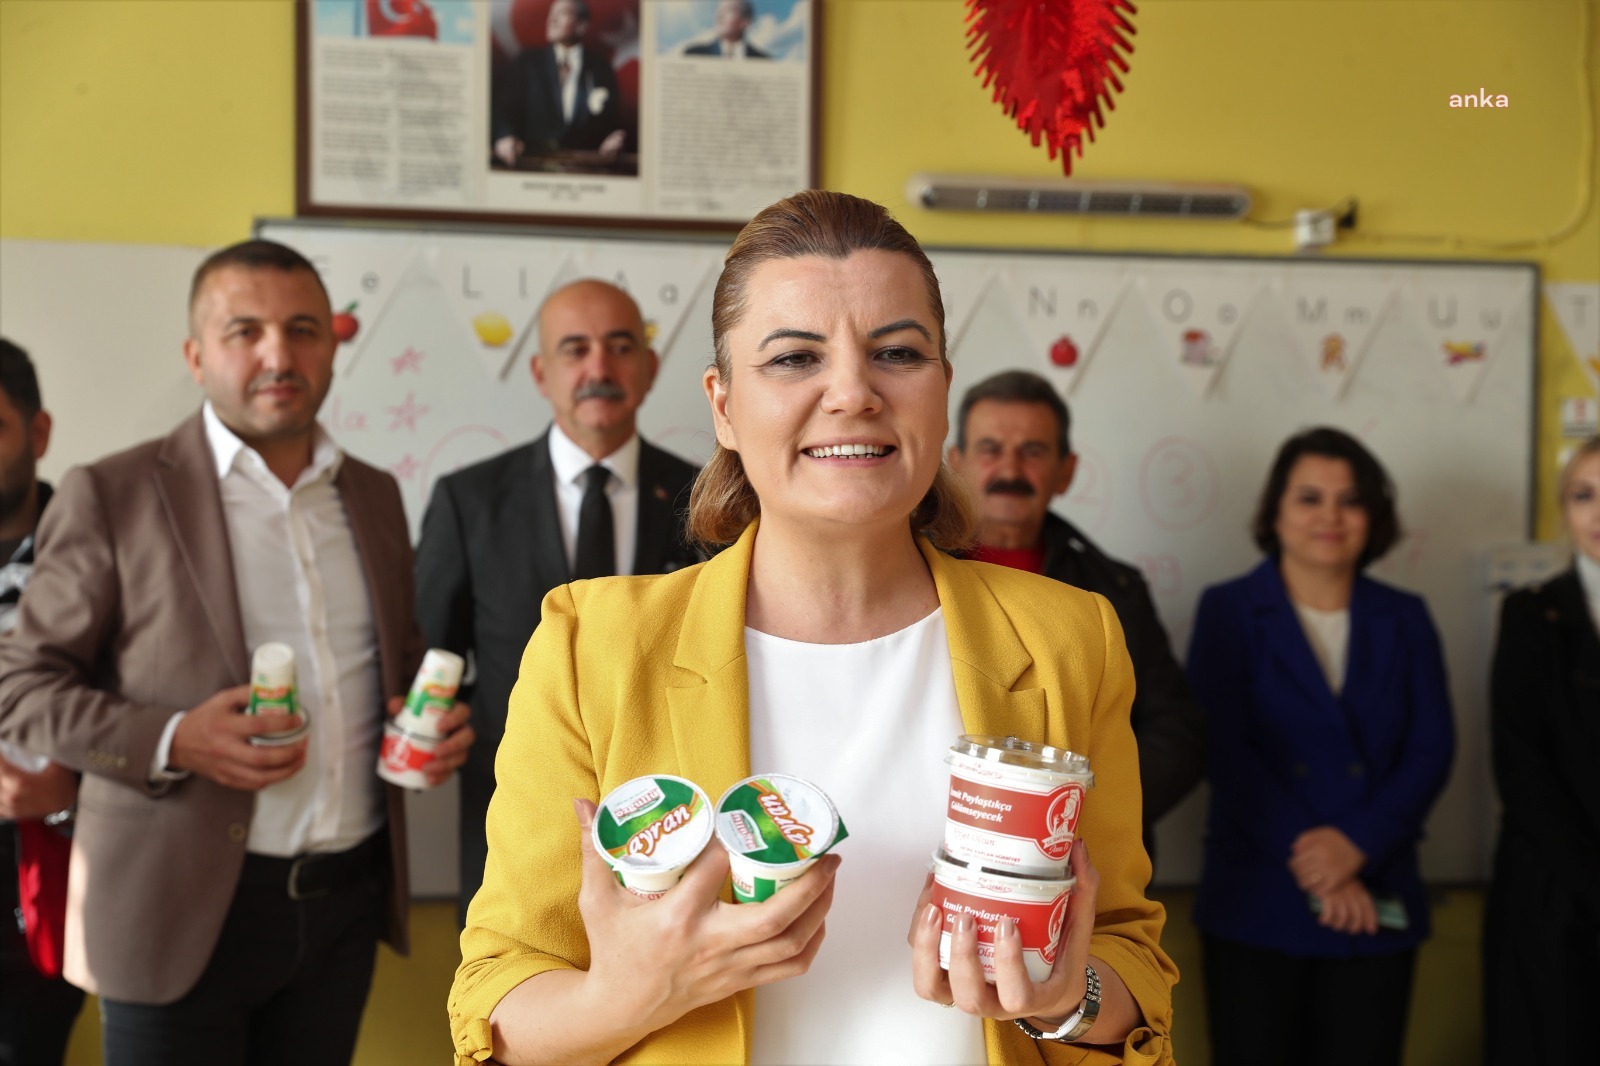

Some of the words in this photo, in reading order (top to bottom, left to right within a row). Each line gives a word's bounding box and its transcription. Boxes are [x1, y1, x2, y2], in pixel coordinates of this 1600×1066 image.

[1028, 285, 1057, 318] N
[628, 805, 690, 856] ayran
[760, 794, 811, 845] ayran
